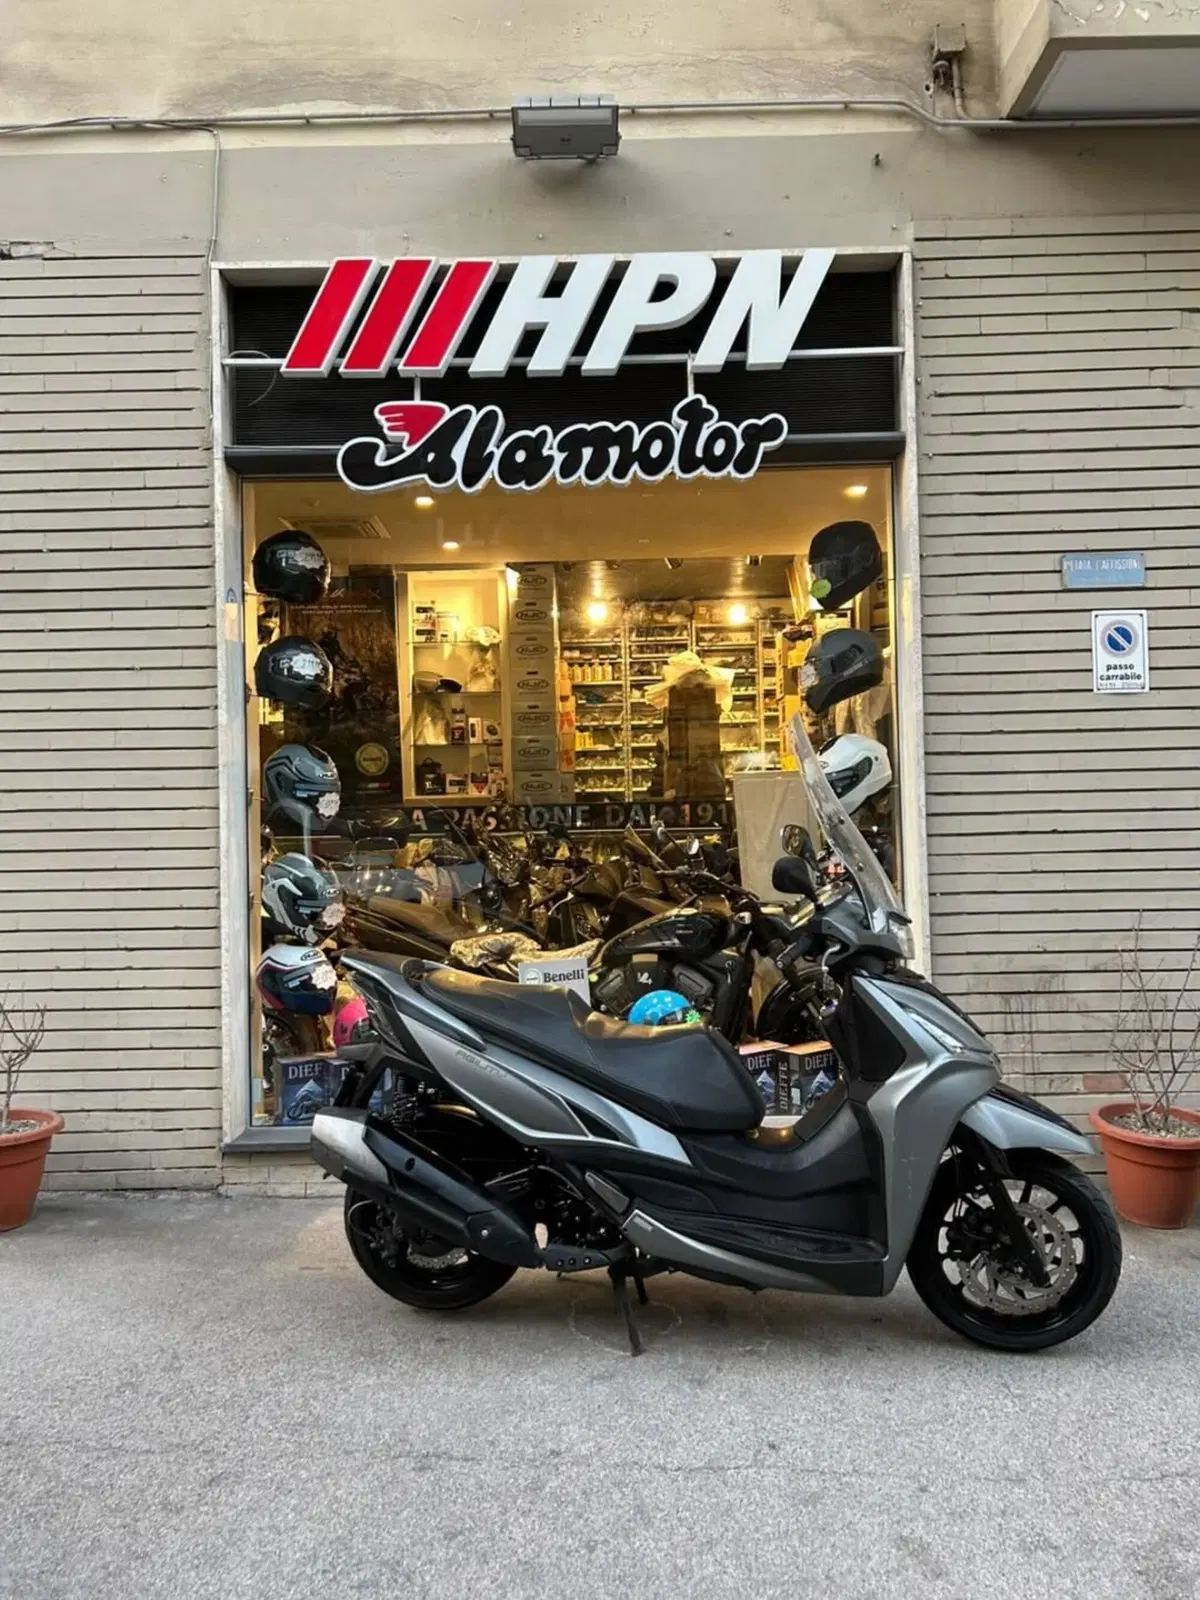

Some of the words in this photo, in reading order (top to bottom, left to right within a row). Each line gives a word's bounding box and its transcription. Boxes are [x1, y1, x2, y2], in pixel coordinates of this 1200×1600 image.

[469, 247, 836, 377] HPN
[335, 393, 789, 493] Alamotor
[1106, 664, 1135, 672] passo
[1100, 672, 1142, 681] carrabile
[543, 968, 585, 984] Benelli
